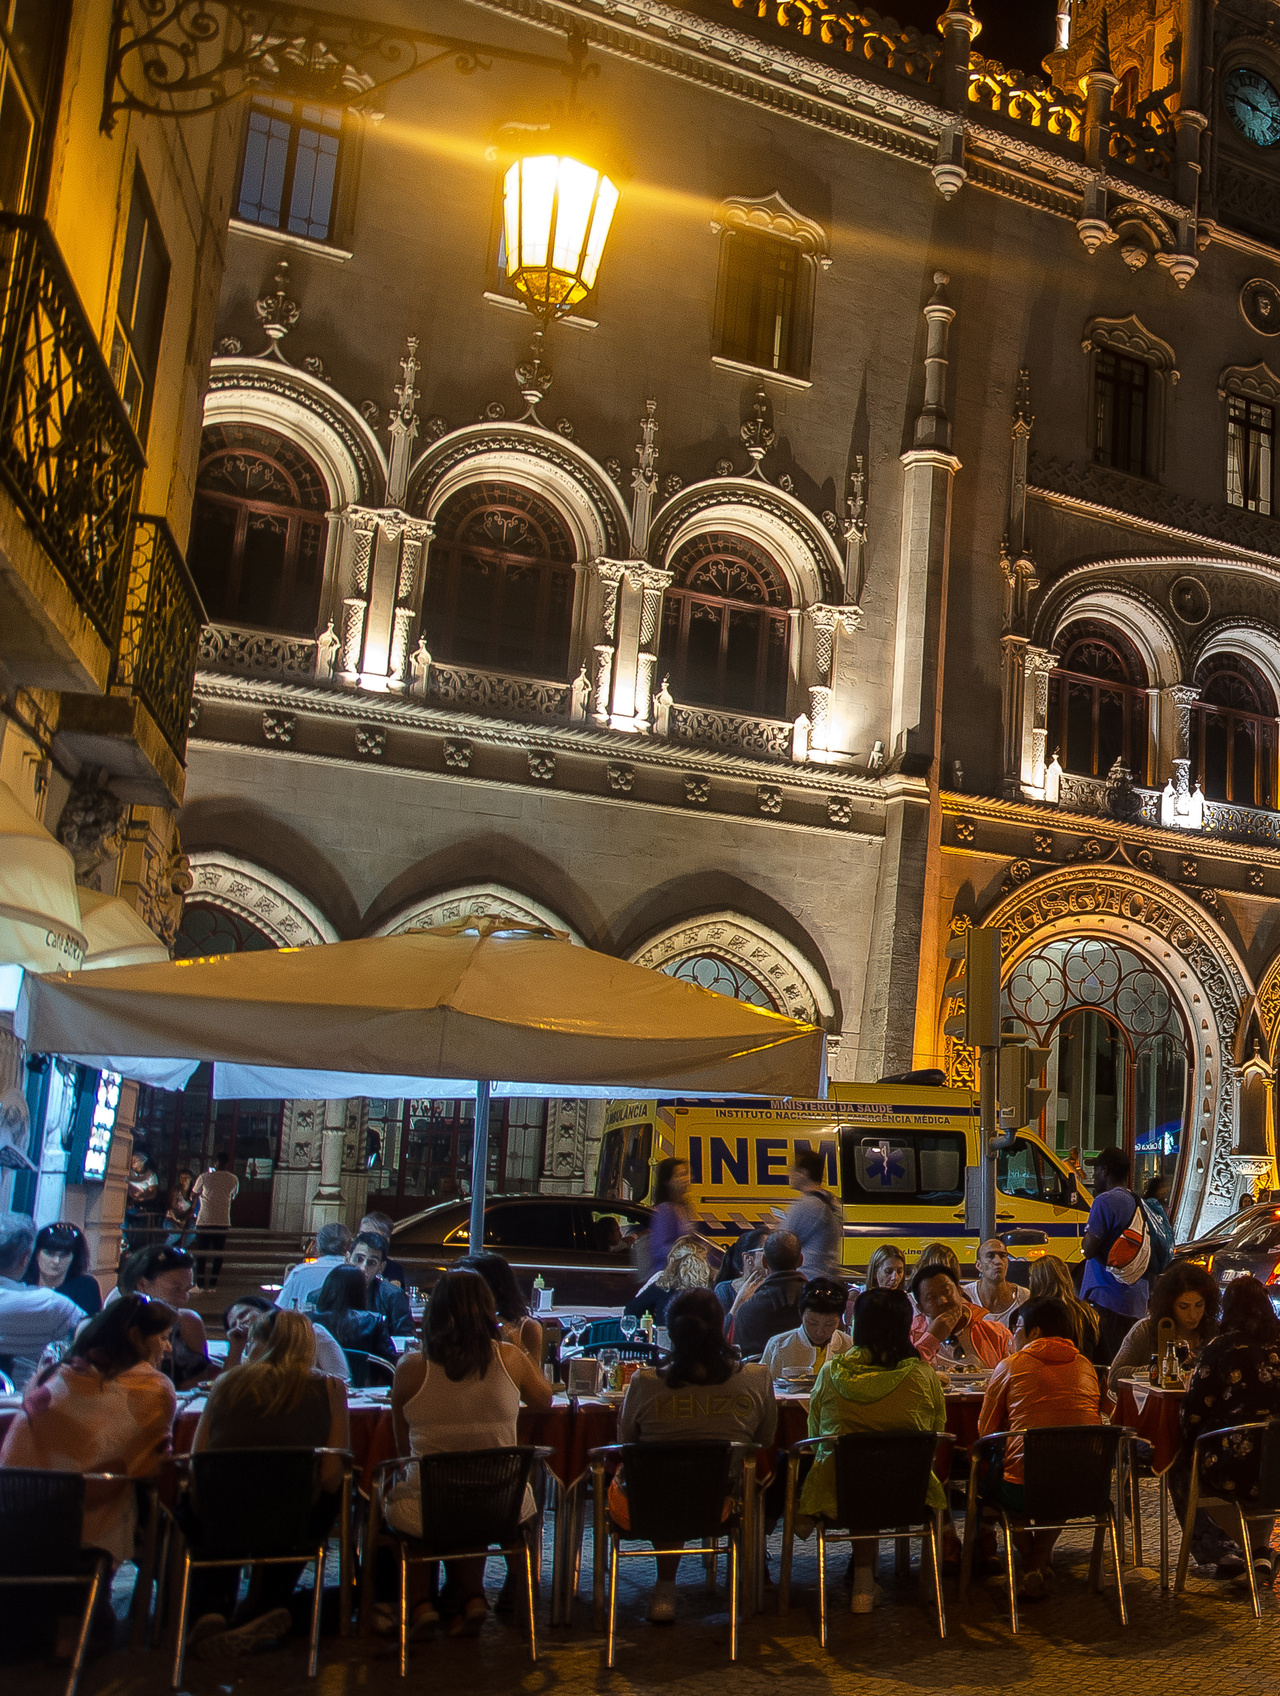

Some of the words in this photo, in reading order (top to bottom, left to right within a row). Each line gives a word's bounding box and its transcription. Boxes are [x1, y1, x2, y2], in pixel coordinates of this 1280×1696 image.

[840, 1103, 854, 1112] DA
[715, 1109, 773, 1119] INSTITUTO
[914, 1115, 951, 1124] MÉDICA
[689, 1136, 838, 1186] INEM
